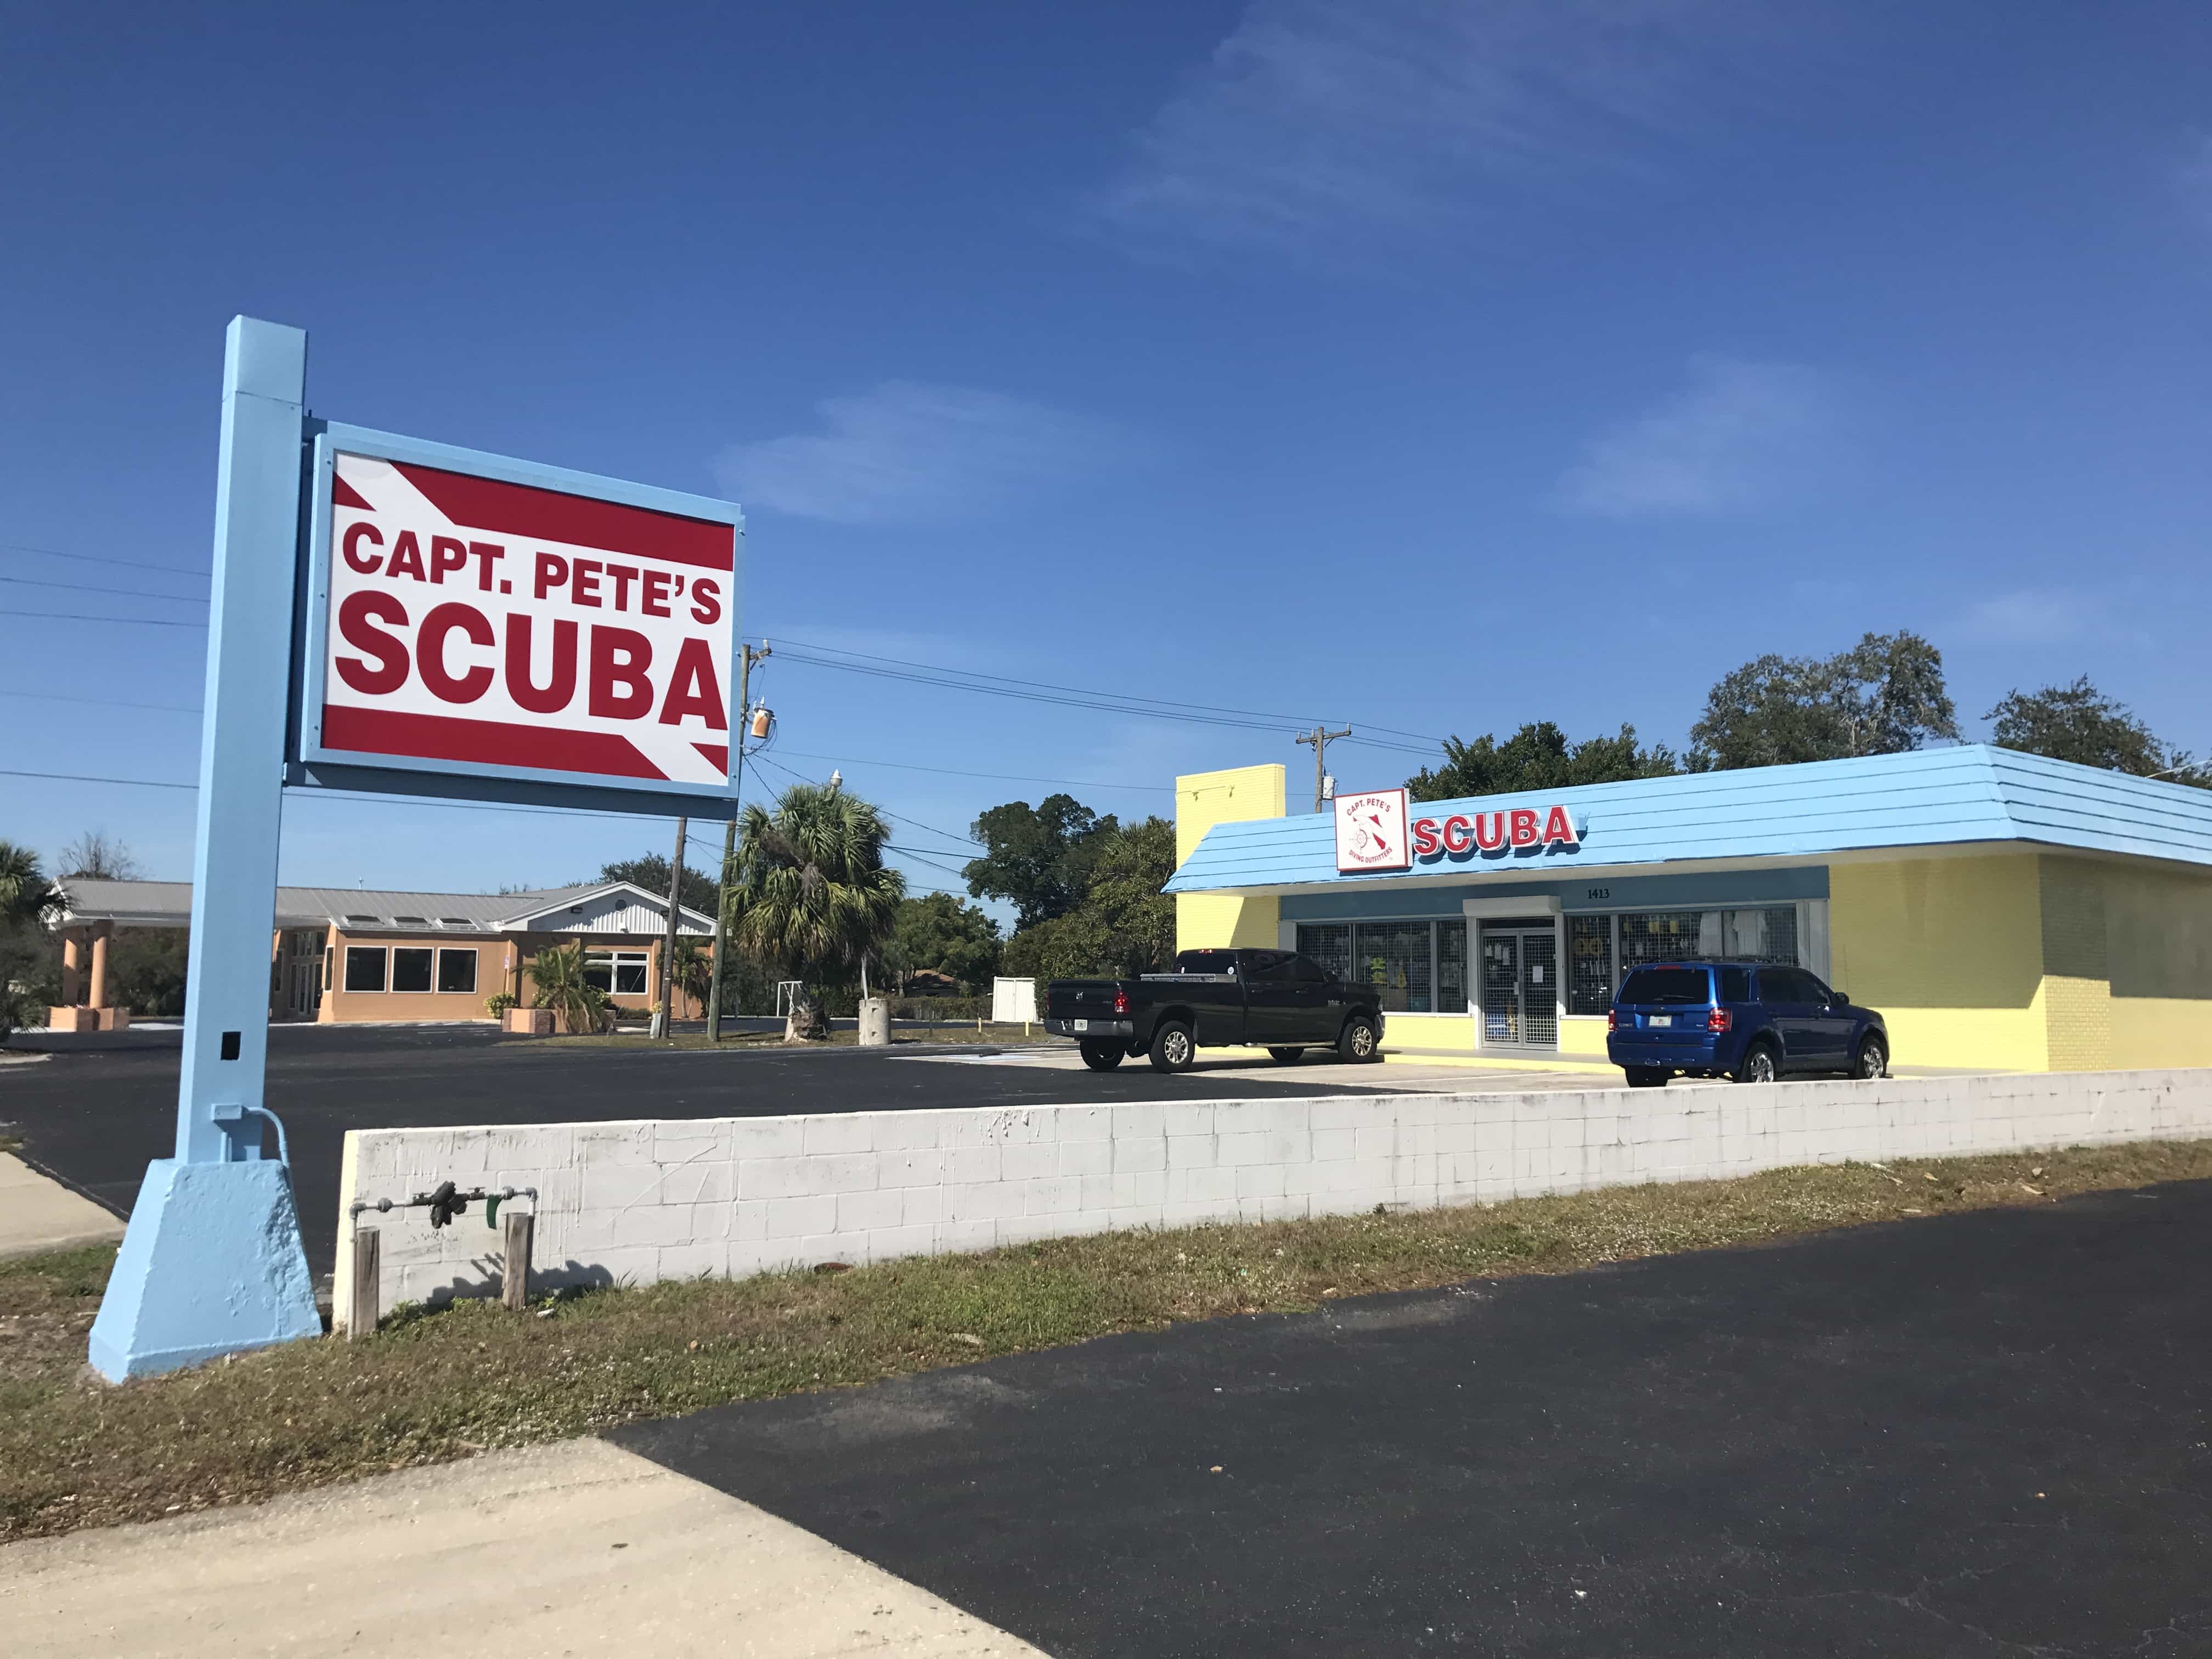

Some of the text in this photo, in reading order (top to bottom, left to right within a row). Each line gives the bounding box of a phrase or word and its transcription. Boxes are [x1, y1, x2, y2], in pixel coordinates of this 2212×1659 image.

[343, 522, 721, 624] CAPT. PETE'S
[335, 590, 728, 731] SCUBA
[1347, 798, 1391, 816] CAPT. PETE'S
[1413, 805, 1575, 856] SCUBA
[1349, 847, 1392, 863] DIVING OUTFITTERS
[1588, 889, 1610, 899] 1413
